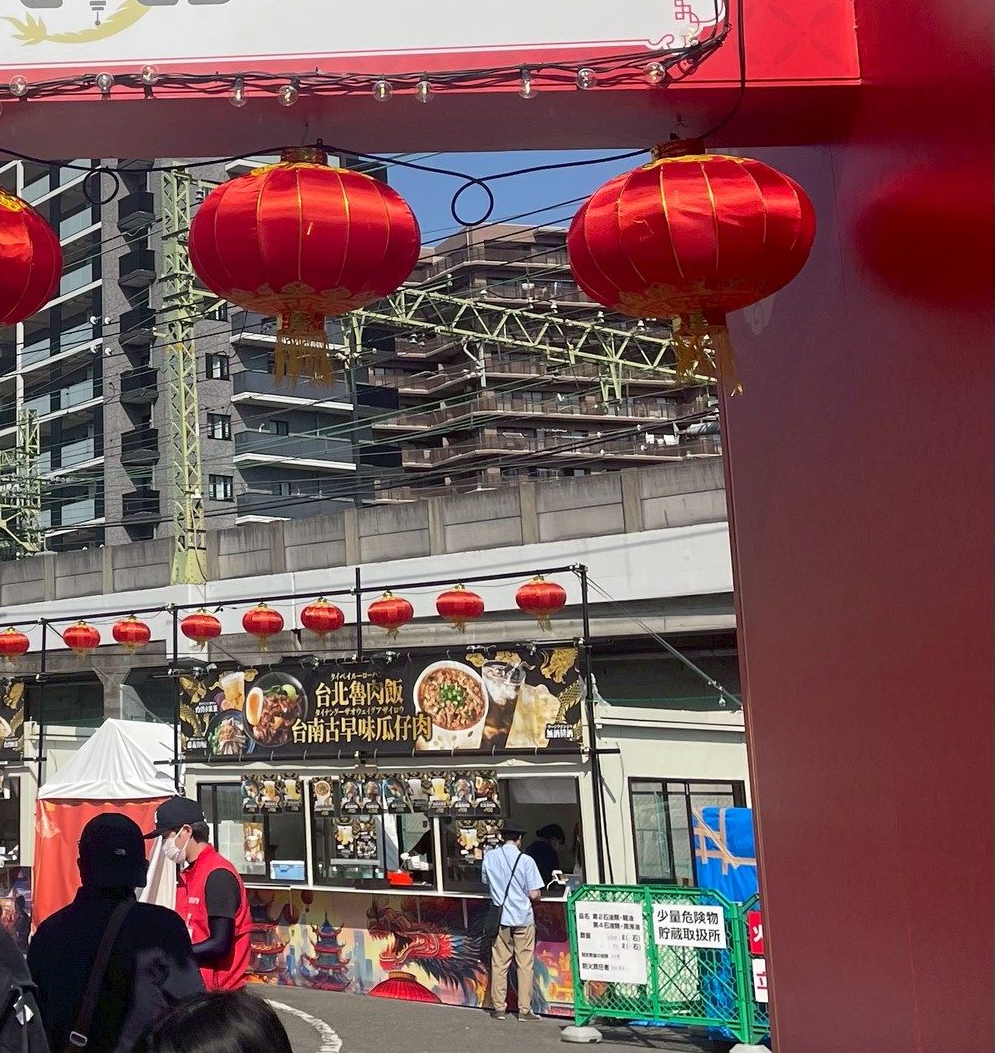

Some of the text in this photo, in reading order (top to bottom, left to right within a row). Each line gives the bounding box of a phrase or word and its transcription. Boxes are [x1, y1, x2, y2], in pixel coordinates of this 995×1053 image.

[315, 679, 404, 707] 台北魯肉飯
[292, 714, 432, 743] 台南古早味瓜仔肉
[657, 909, 719, 925] 少量危険物
[658, 926, 721, 943] 貯蔵取扱所
